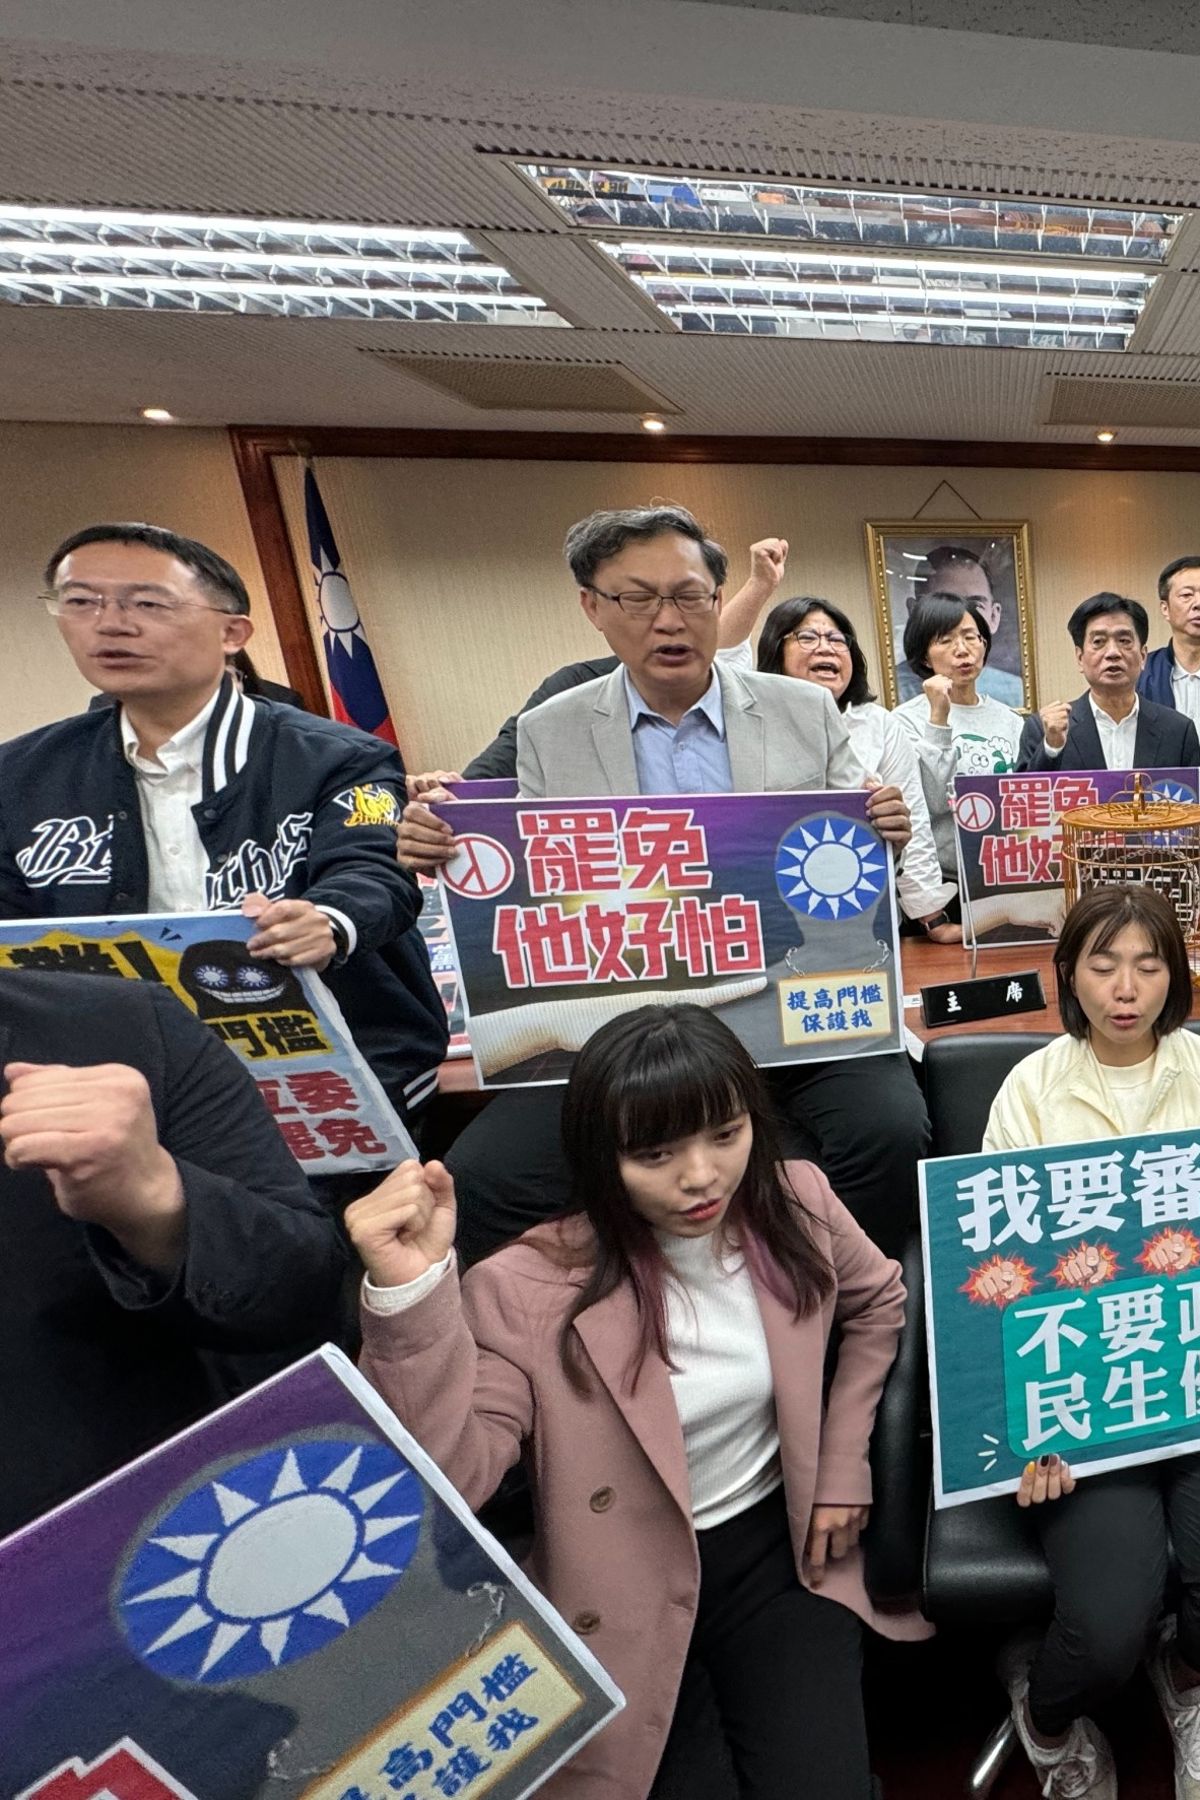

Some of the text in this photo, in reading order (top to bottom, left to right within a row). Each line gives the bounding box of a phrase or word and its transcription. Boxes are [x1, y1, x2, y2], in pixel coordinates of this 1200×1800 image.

[517, 807, 713, 897] 罷免
[493, 894, 766, 989] 他好怕
[787, 985, 883, 1010] 提高門檻
[801, 1010, 873, 1033] 保護我
[381, 1707, 540, 1800] 護我
